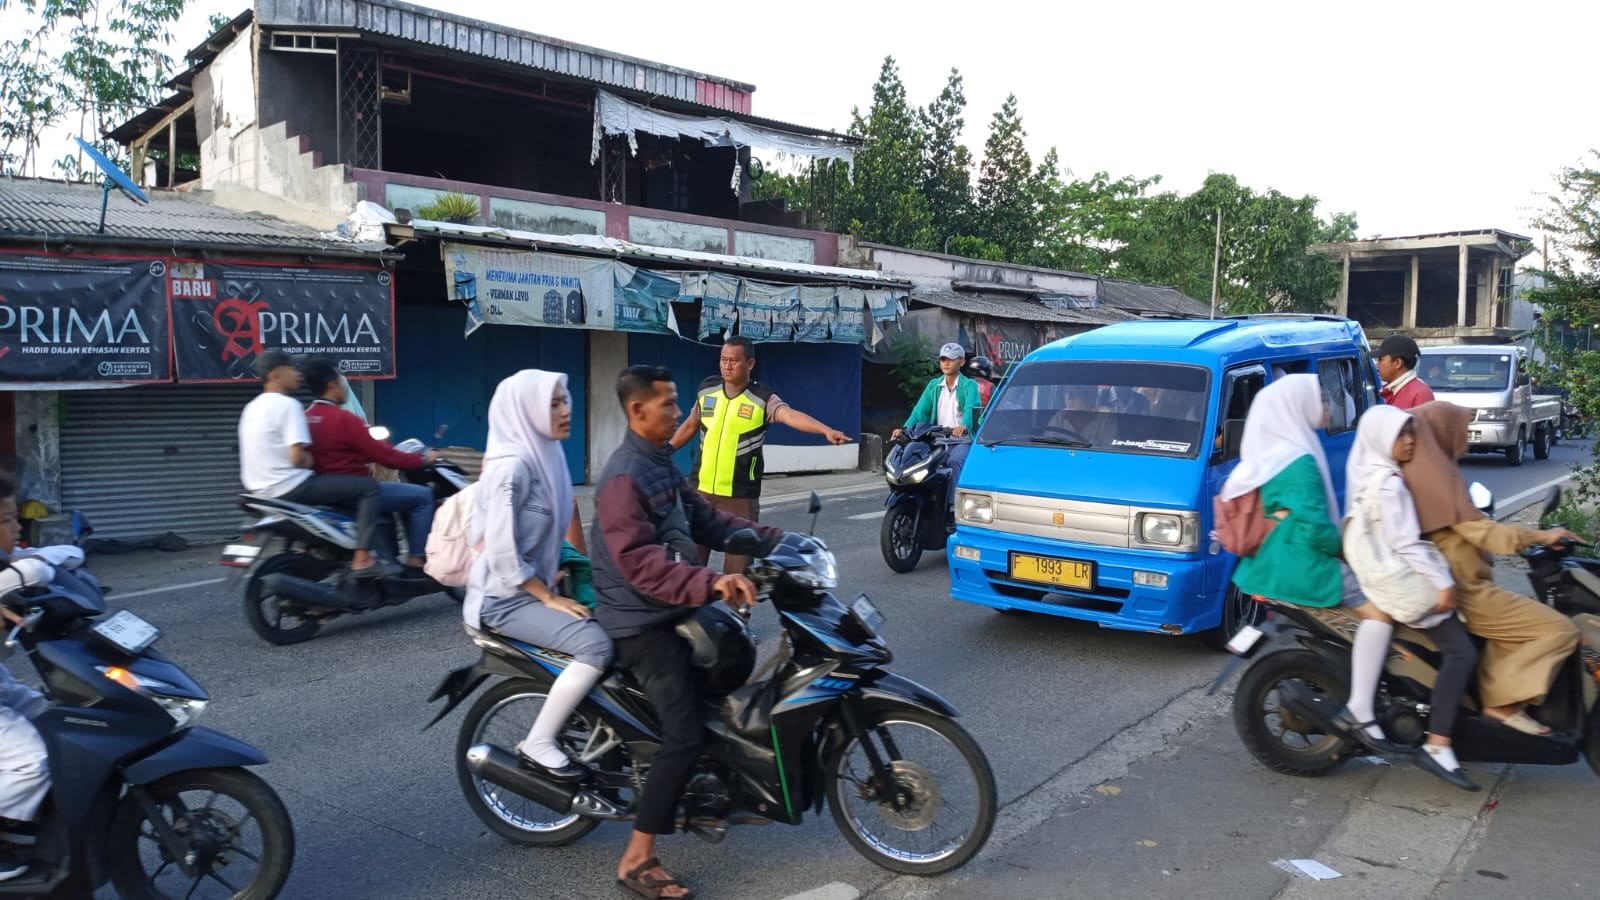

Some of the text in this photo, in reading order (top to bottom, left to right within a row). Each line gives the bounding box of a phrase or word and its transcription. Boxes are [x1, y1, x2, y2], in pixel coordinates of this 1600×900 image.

[172, 279, 212, 297] BARU
[486, 269, 517, 283] MENERIMA
[517, 271, 541, 286] JAHITAN
[541, 274, 555, 287] PRIA
[560, 276, 581, 289] WANITA
[489, 288, 514, 301] VERMAK
[258, 311, 381, 344] PRIMA
[22, 346, 151, 354] HADIR DALAM KEMASAN KERTAS
[1014, 555, 1089, 579] F 1993 LR
